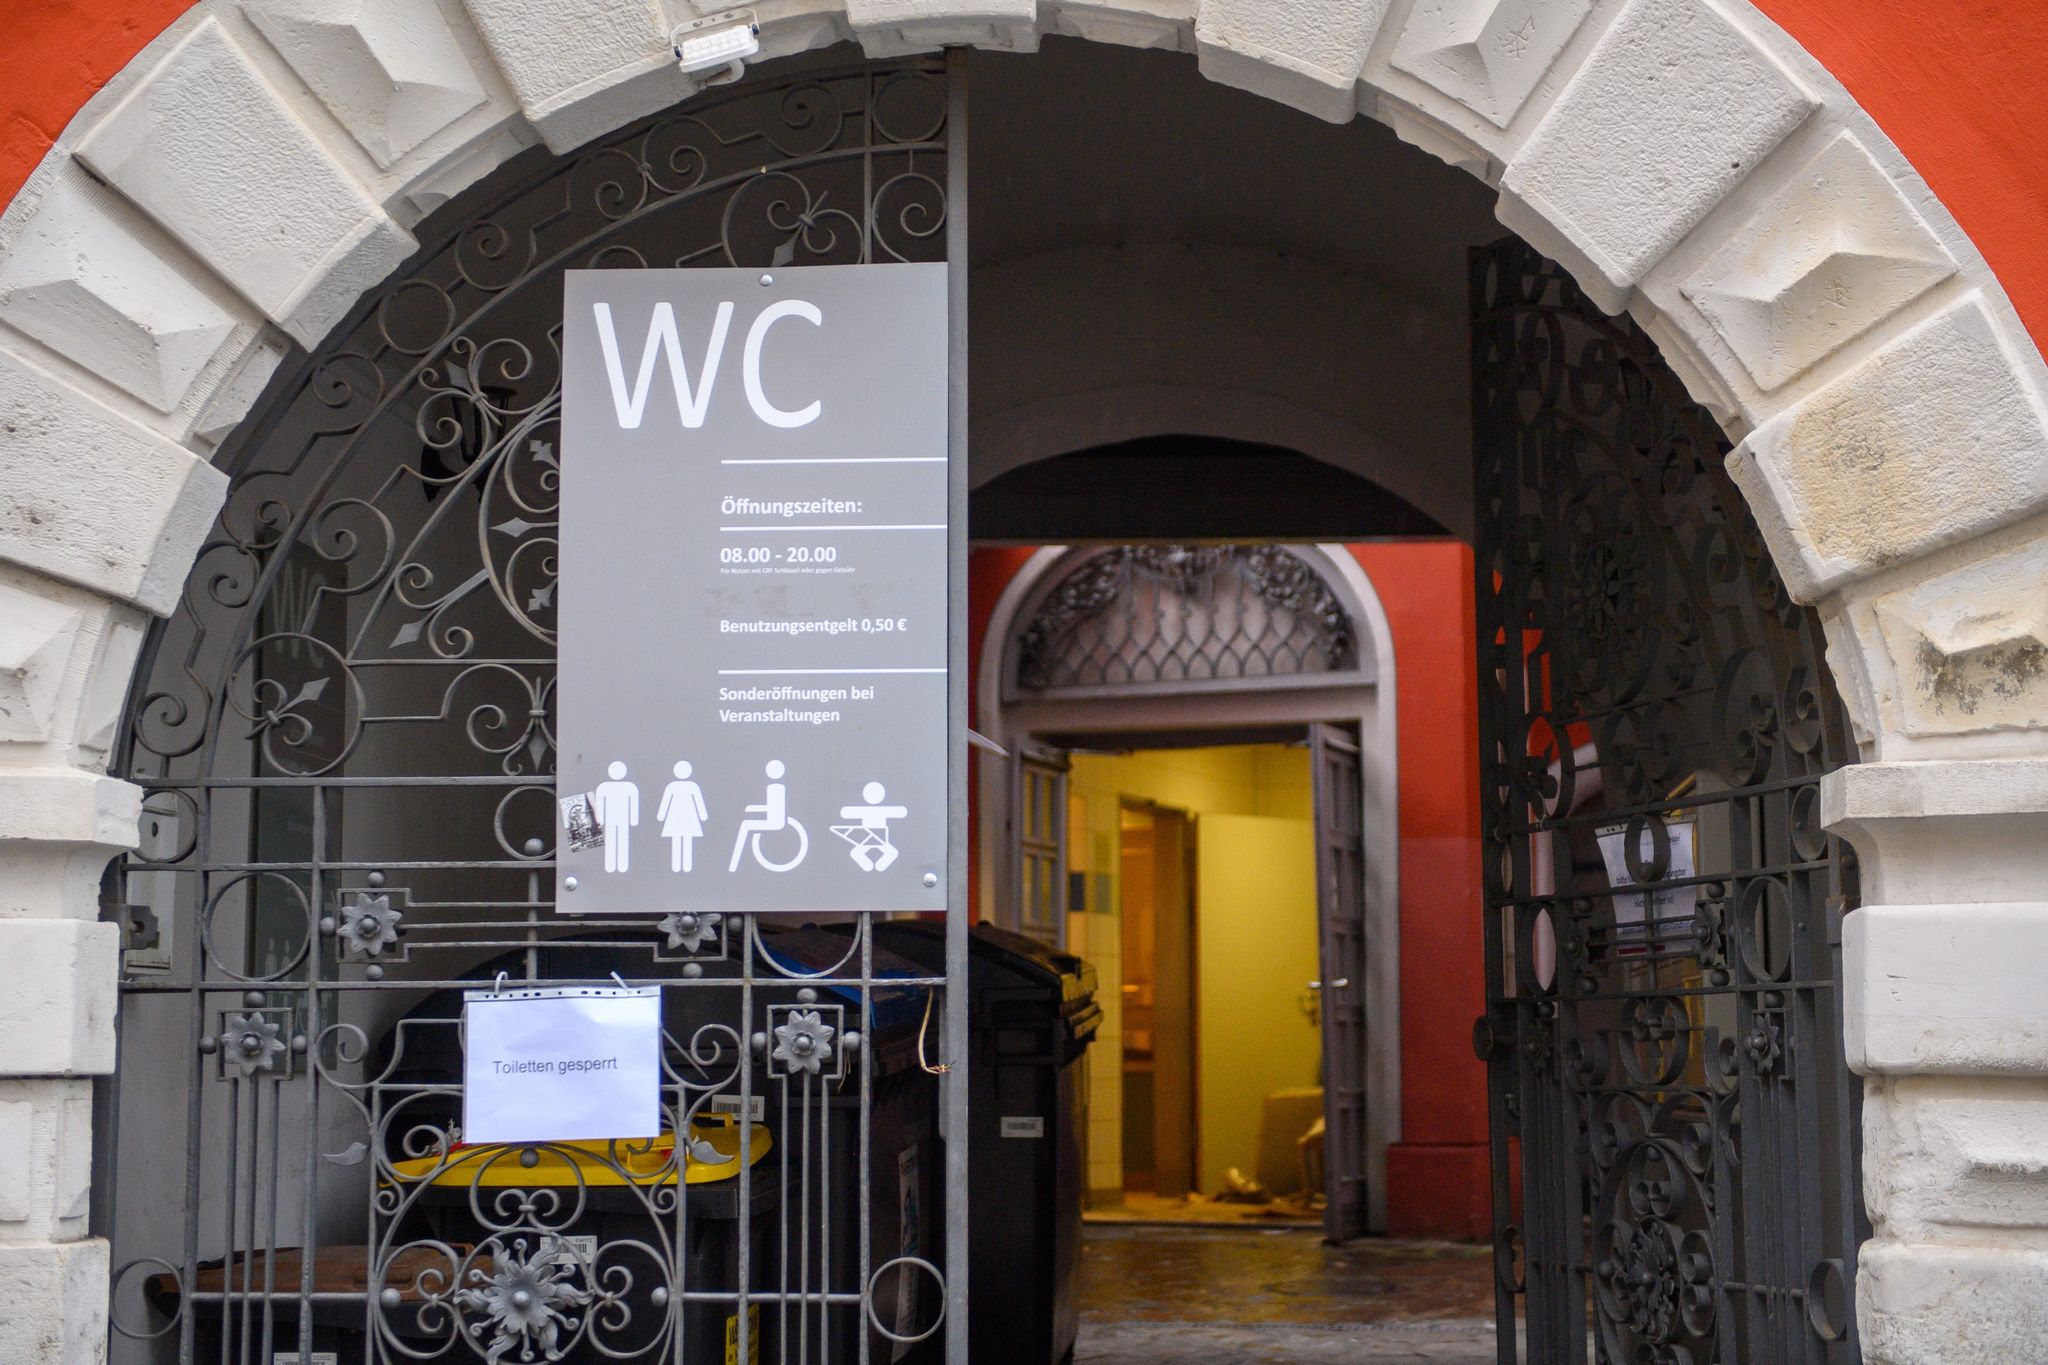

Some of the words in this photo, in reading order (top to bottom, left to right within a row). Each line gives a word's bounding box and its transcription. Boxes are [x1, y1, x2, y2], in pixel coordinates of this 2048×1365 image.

[593, 299, 823, 429] WC
[720, 495, 863, 518] Öffnungszeiten:
[719, 547, 771, 563] 08.00
[786, 546, 837, 562] 20.00
[720, 618, 858, 636] Benutzungsentgelt
[861, 618, 894, 633] 0,50
[897, 618, 907, 632] €
[719, 686, 847, 702] Sonderöffnungen
[851, 686, 875, 700] bei
[719, 708, 840, 724] Veranstaltungen
[492, 1059, 554, 1074] Toiletten
[558, 1056, 618, 1075] gesperrt
